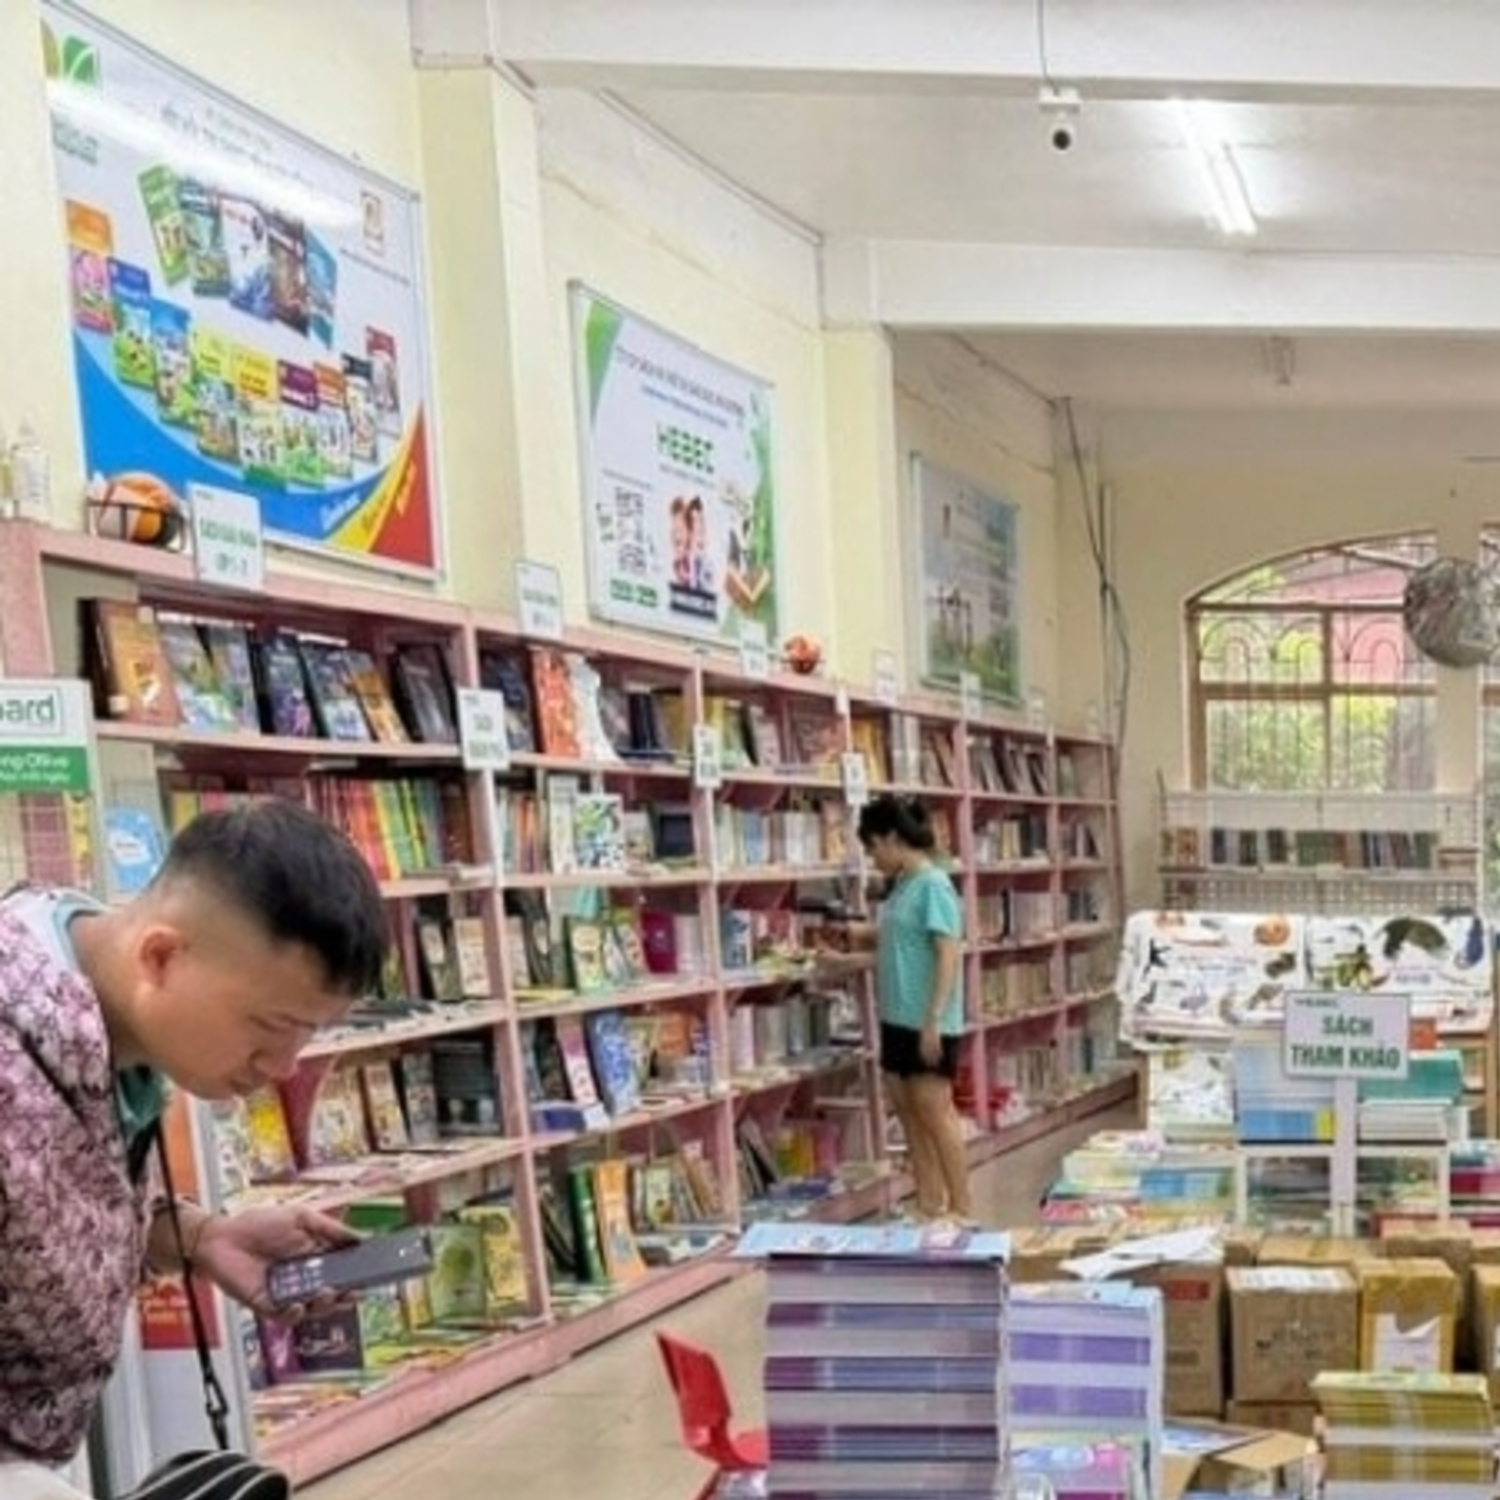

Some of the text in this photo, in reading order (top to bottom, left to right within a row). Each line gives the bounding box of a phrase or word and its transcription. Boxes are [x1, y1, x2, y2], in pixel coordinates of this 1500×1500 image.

[0, 691, 55, 722] ard
[1321, 1012, 1374, 1037] SÁCH
[1290, 1041, 1401, 1070] THAM KHẢO
